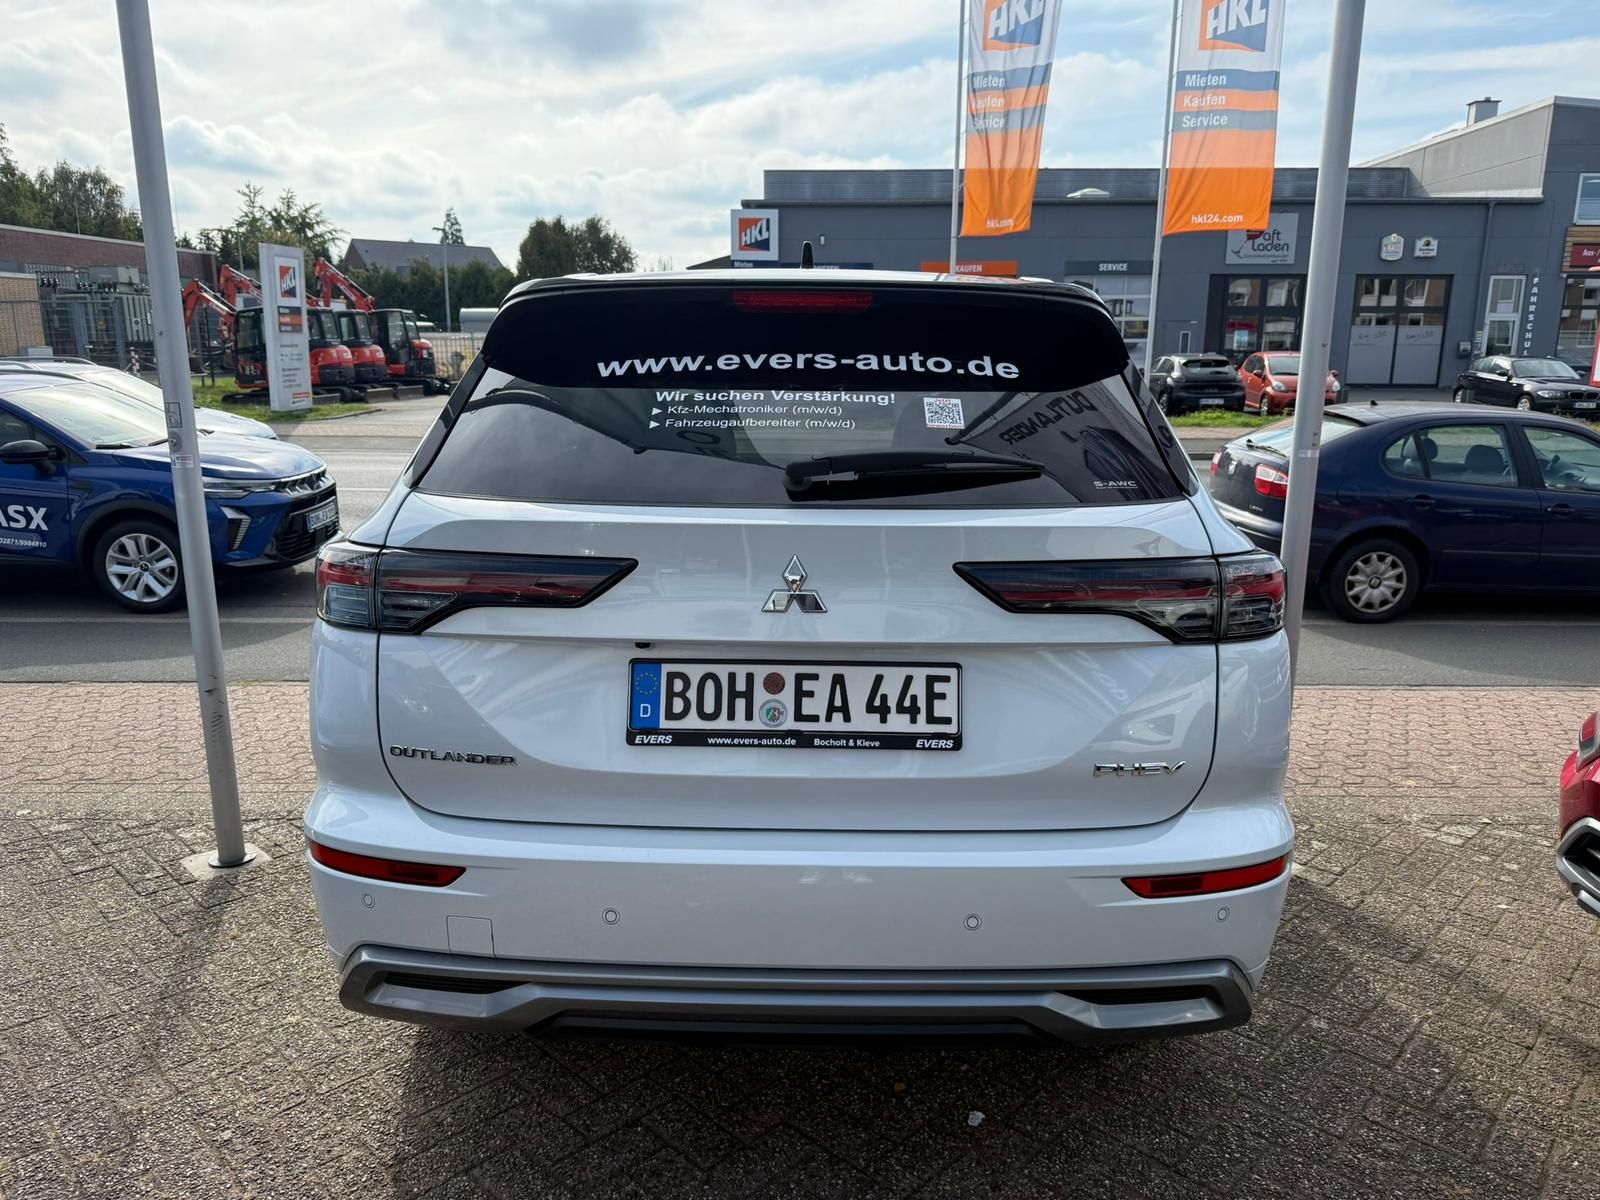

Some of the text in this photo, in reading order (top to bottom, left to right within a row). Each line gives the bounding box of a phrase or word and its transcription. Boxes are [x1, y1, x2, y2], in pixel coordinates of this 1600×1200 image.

[1205, 0, 1267, 39] HKL
[973, 74, 1006, 89] Mieten
[1184, 74, 1227, 87] Mieten
[1183, 93, 1226, 107] Kaufen
[1182, 113, 1228, 128] Service
[1191, 214, 1244, 224] hkl24.com
[741, 218, 769, 247] HKL
[1099, 263, 1128, 272] SERVICE
[597, 351, 1020, 379] www.evers-auto.de
[656, 390, 896, 406] Wir suchen Verstärkung!
[667, 405, 842, 416] Kfz-Mechatroniker (m/w/d)
[665, 418, 856, 430] Fahrzeugaufbereiter (m/w/d)
[665, 671, 953, 724] BOH EA 44E
[639, 704, 651, 717] D
[635, 735, 954, 748] EVERS www.evers-auto.de Bocholt & Kleve EVERS
[390, 744, 518, 767] OUTLANDER
[1093, 760, 1186, 776] PHEV
